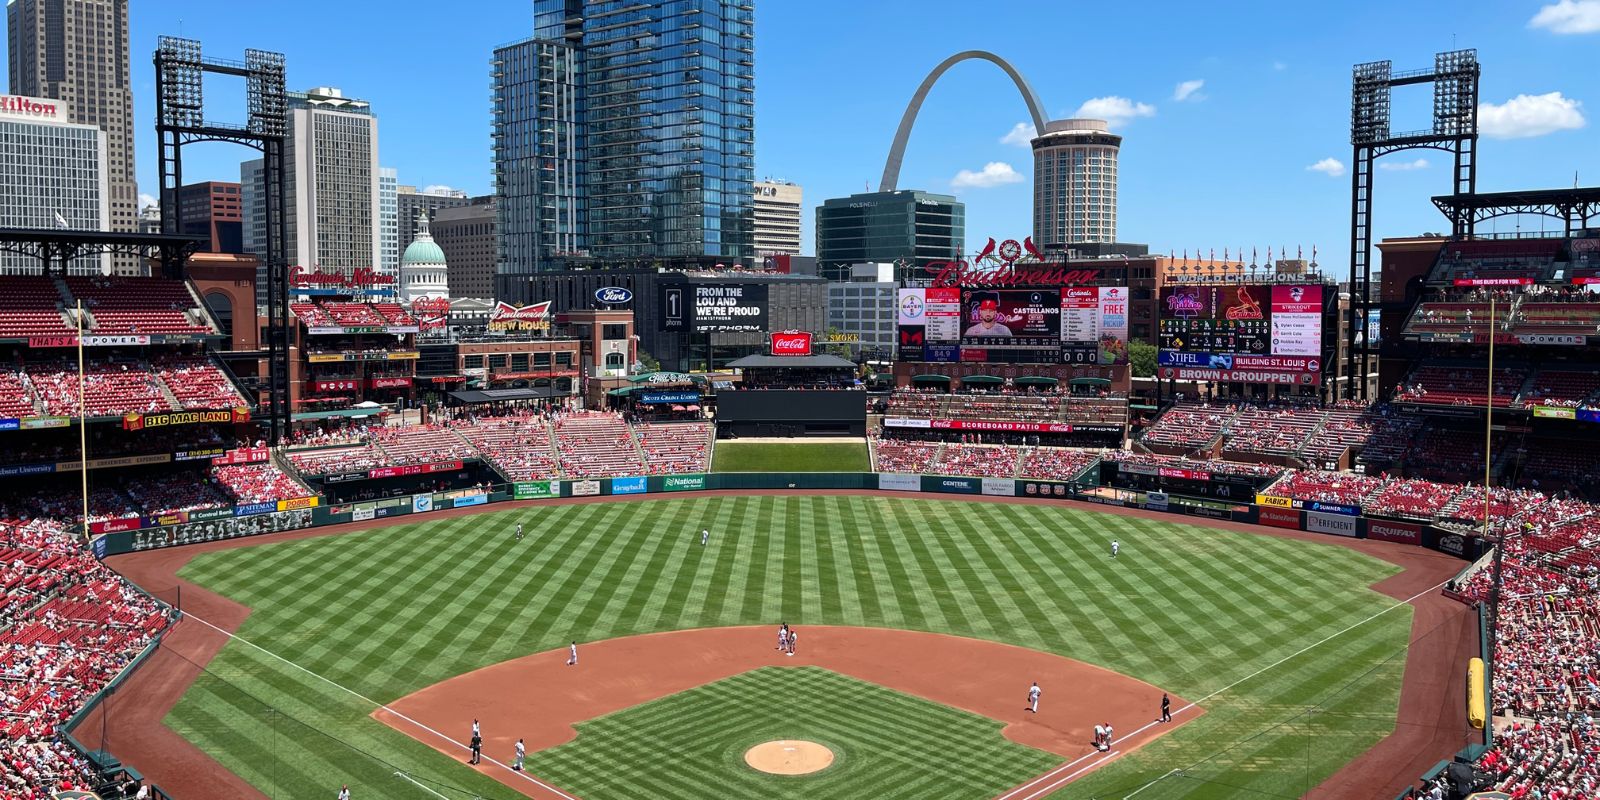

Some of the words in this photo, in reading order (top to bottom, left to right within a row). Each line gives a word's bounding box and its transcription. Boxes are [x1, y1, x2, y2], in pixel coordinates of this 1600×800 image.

[287, 264, 346, 288] Cardinals
[345, 267, 395, 288] Nation
[925, 260, 1101, 290] Budweiser
[1225, 273, 1305, 282] CHAMPIONS
[603, 289, 626, 300] Ford
[696, 287, 719, 297] FROM
[721, 287, 742, 297] THE
[1067, 289, 1092, 297] Cardinals
[696, 297, 714, 306] LOU
[717, 297, 736, 306] AND
[696, 306, 726, 316] WE'RE
[728, 306, 761, 316] PROUD
[1104, 304, 1124, 314] FREE
[489, 306, 550, 322] Budweiser
[489, 322, 517, 331] BREW
[518, 321, 550, 330] HOUSE
[31, 336, 64, 346] THAT'S
[67, 337, 73, 345] A
[829, 334, 859, 343] SMOKE
[776, 338, 806, 349] Coca-Cola
[1064, 353, 1071, 361] 0
[1077, 353, 1083, 361] 0
[1089, 353, 1096, 361] 0
[1168, 352, 1198, 363] STIFEL
[1235, 357, 1270, 366] BUILDING
[1179, 369, 1221, 380] BROWN
[1222, 372, 1229, 380] &
[1231, 372, 1295, 383] CROUPPEN
[145, 416, 169, 427] BIG
[170, 413, 199, 424] MAC
[200, 412, 231, 421] LAND
[932, 421, 951, 429] Coca-Cola
[961, 422, 1013, 430] SCOREBOARD
[20, 465, 52, 473] University
[673, 477, 703, 485] National
[942, 480, 969, 488] CENTENE
[286, 498, 310, 507] DOBBS
[1264, 497, 1288, 506] FABICK
[1293, 500, 1304, 508] CAT
[245, 502, 275, 511] SITEMAN
[1371, 524, 1417, 537] EQUIFAX
